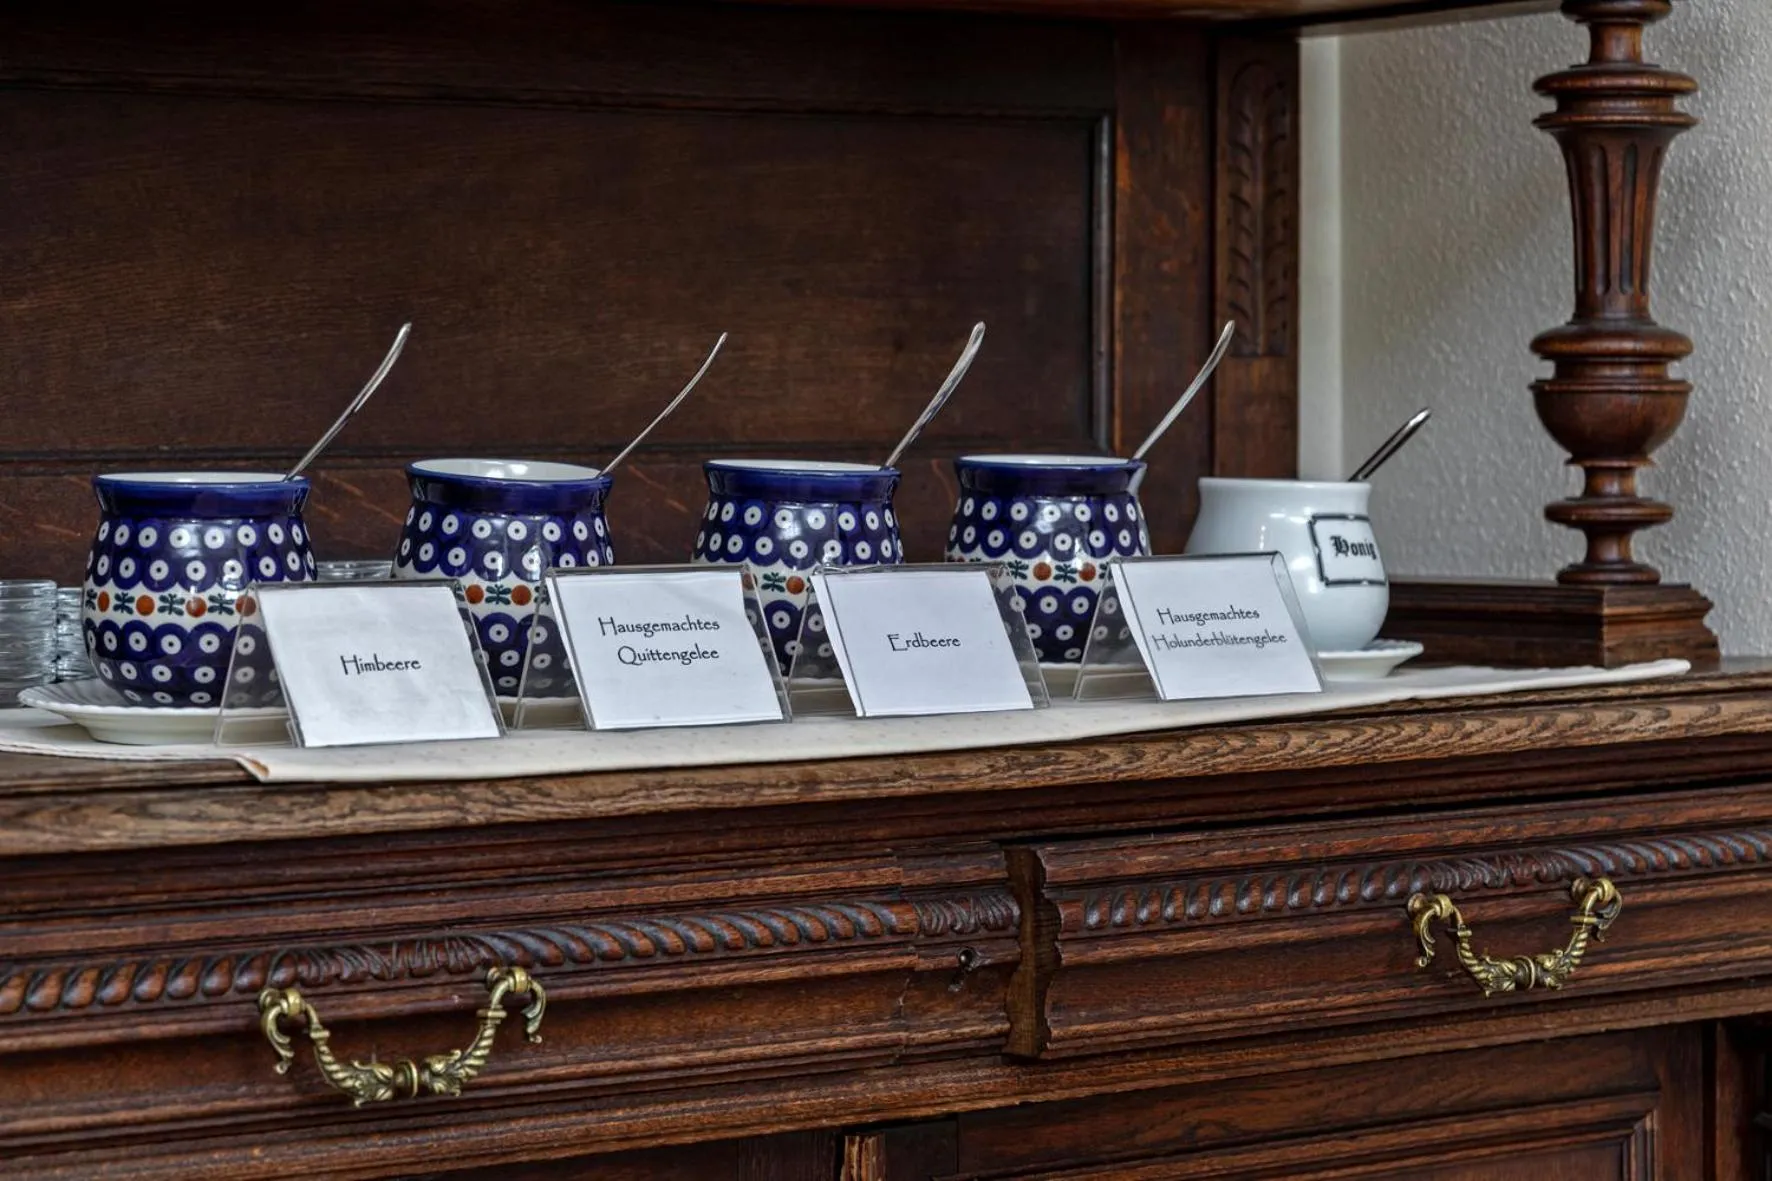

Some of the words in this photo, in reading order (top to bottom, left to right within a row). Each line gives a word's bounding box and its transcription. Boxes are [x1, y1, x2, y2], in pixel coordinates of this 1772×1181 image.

[1330, 535, 1377, 561] Honig
[598, 614, 720, 638] Hausgemachtes
[1156, 604, 1261, 627] Hausgemachtes
[887, 632, 961, 652] Erdbeere
[1151, 629, 1288, 651] Holunderblütengelee
[340, 654, 422, 676] Himbeere
[616, 643, 720, 667] Quittengelee
